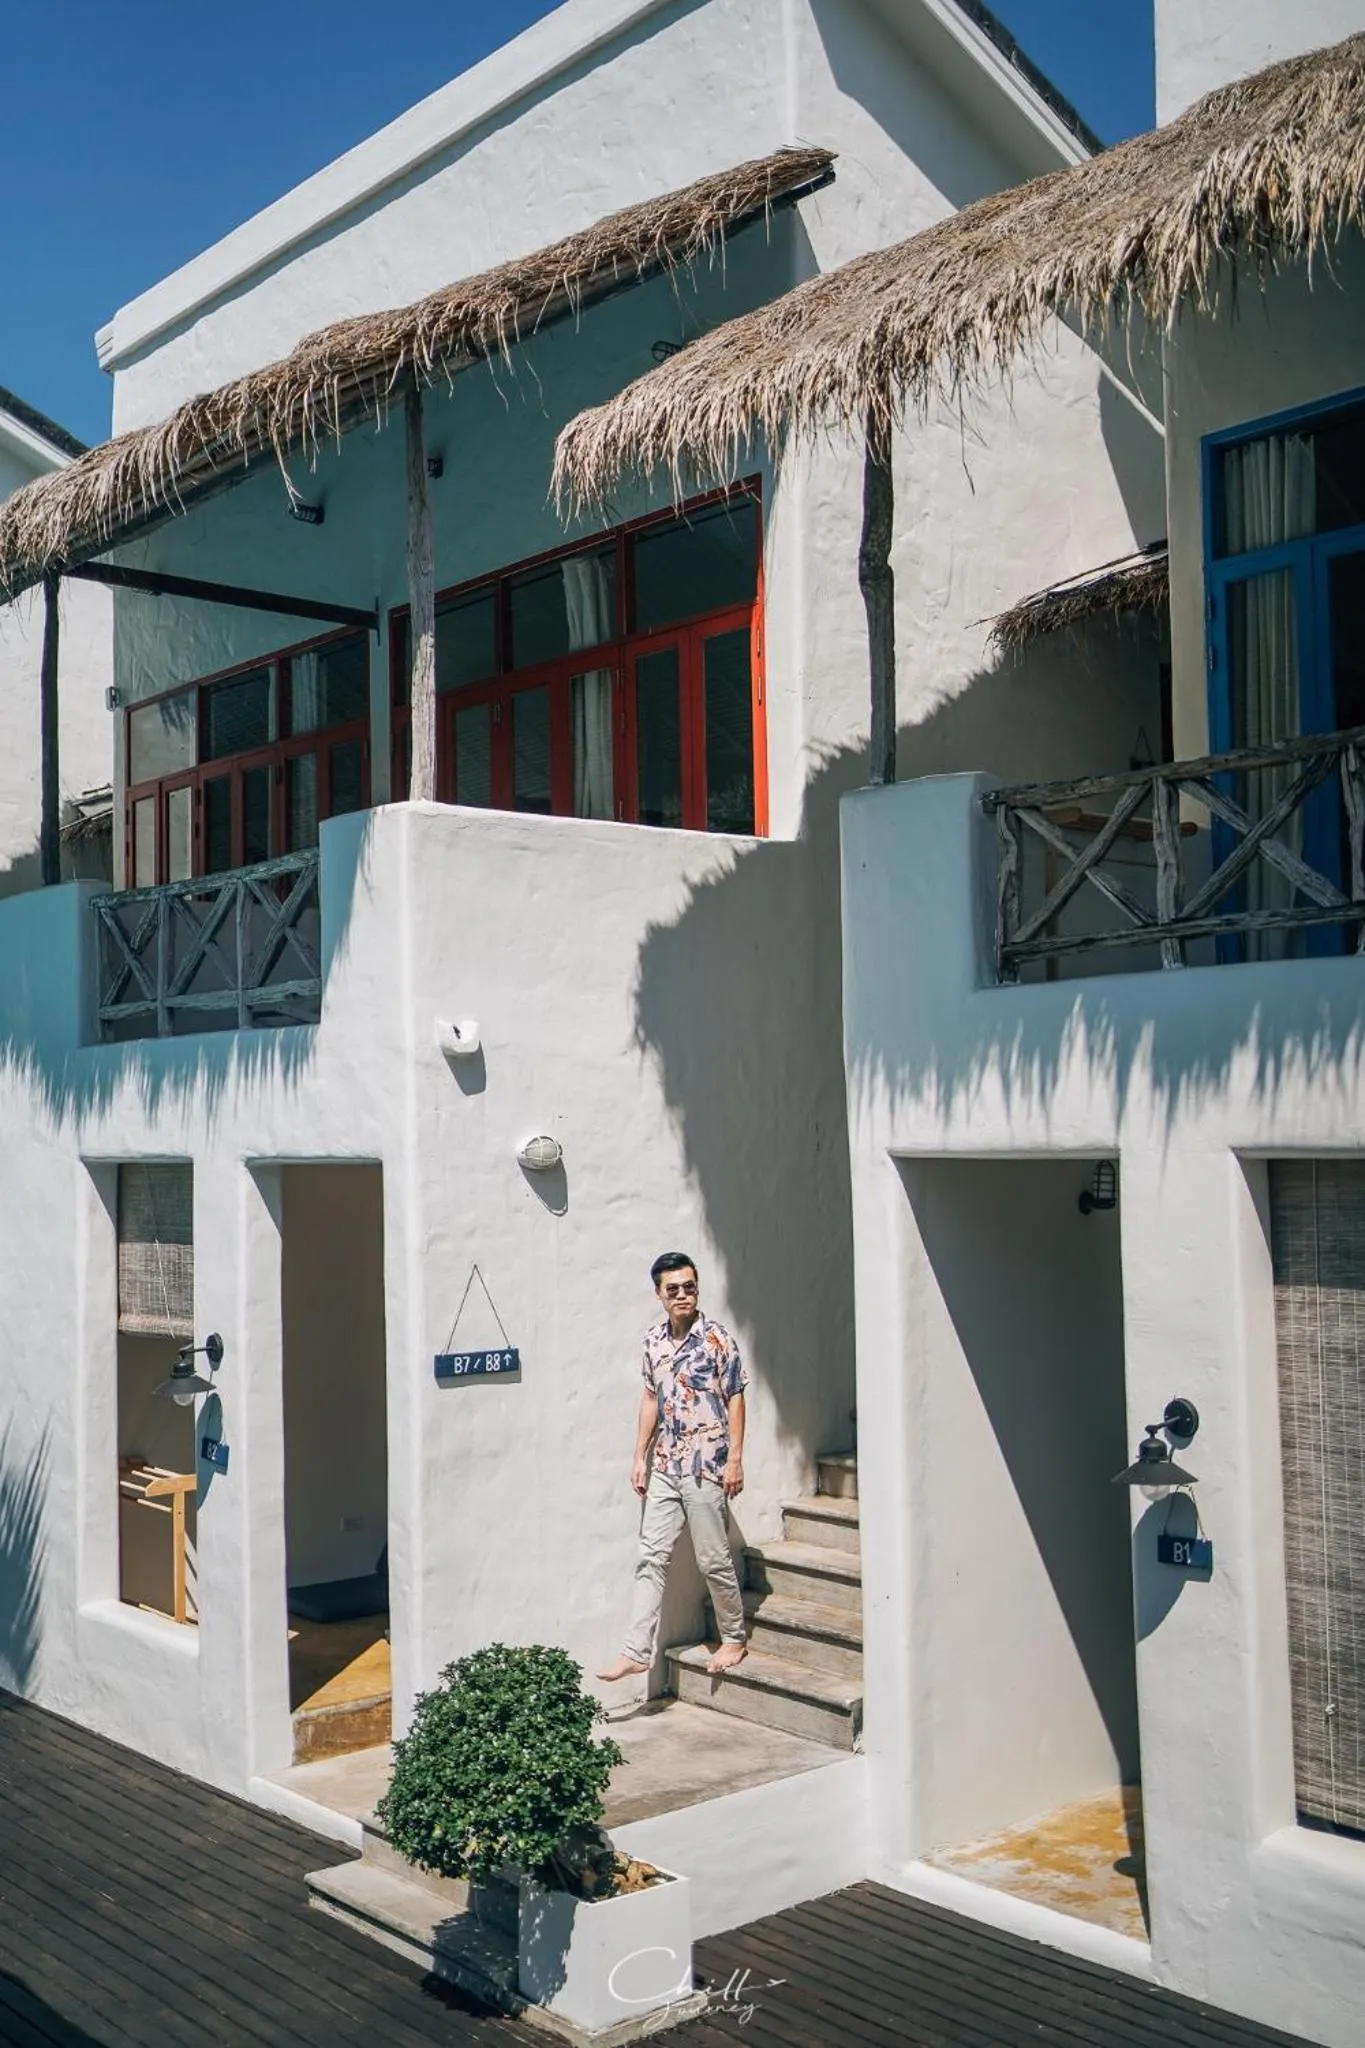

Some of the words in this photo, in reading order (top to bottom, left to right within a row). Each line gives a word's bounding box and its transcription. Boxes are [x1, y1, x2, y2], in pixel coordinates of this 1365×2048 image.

[454, 1356, 470, 1374] B7
[485, 1353, 501, 1371] B8
[1173, 1542, 1191, 1564] B1
